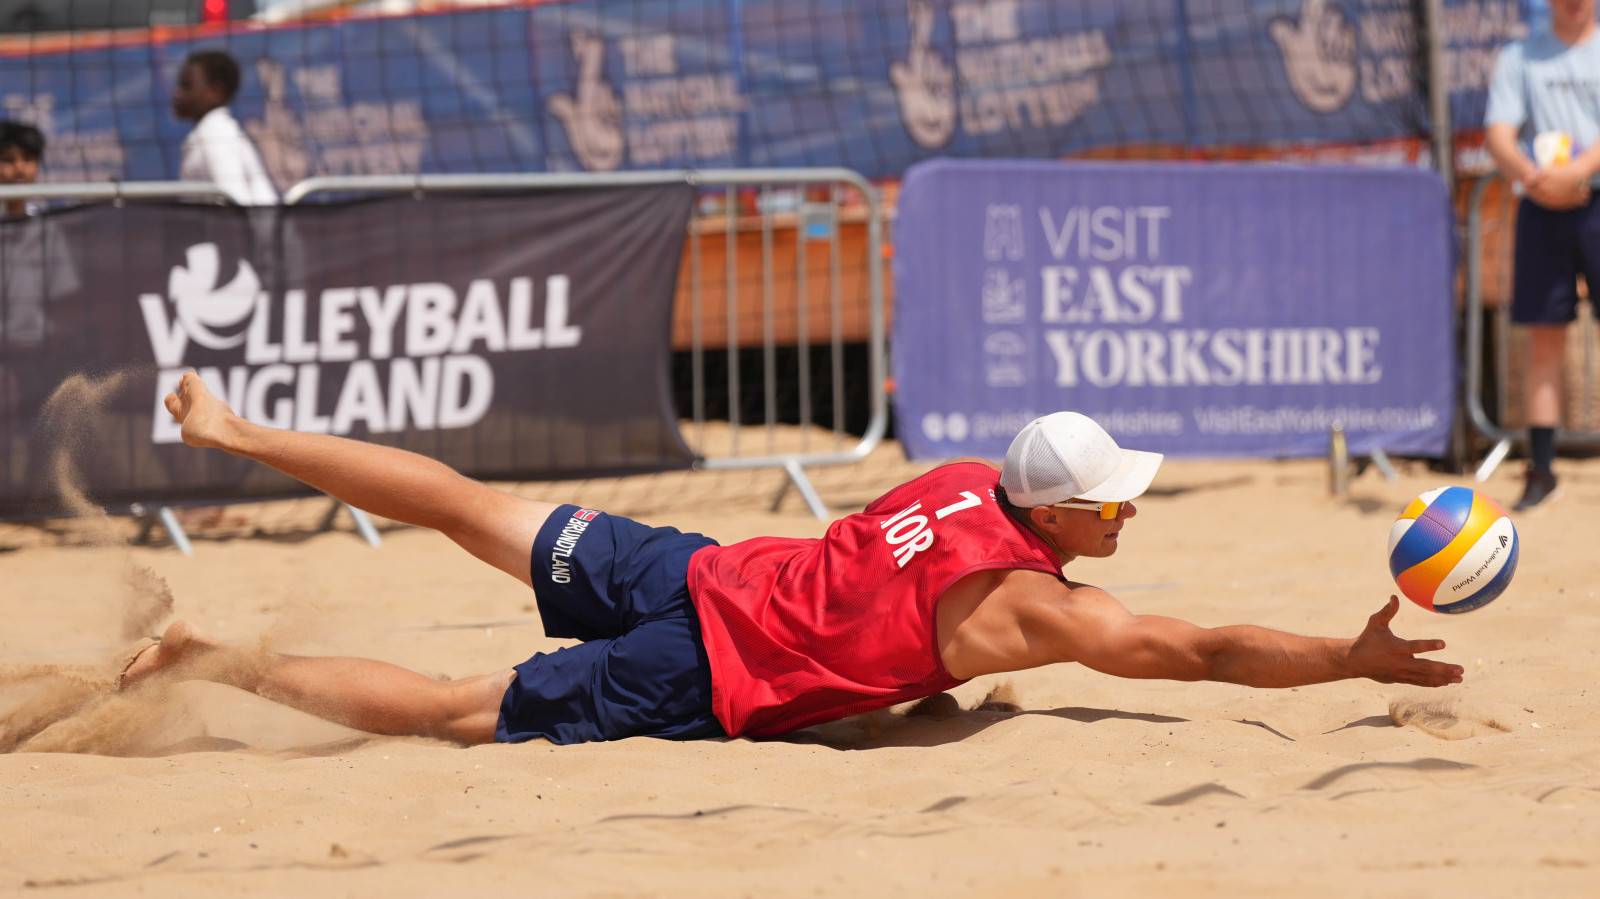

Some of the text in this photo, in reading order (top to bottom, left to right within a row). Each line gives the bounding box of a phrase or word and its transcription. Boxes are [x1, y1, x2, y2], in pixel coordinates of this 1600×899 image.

[1038, 205, 1171, 261] VISIT
[1041, 265, 1193, 323] EAST
[1044, 327, 1384, 388] YORKSHIRE
[935, 491, 982, 520] 1
[552, 518, 589, 584] BRUNDTLAND
[1452, 547, 1501, 592] Volleyball World
